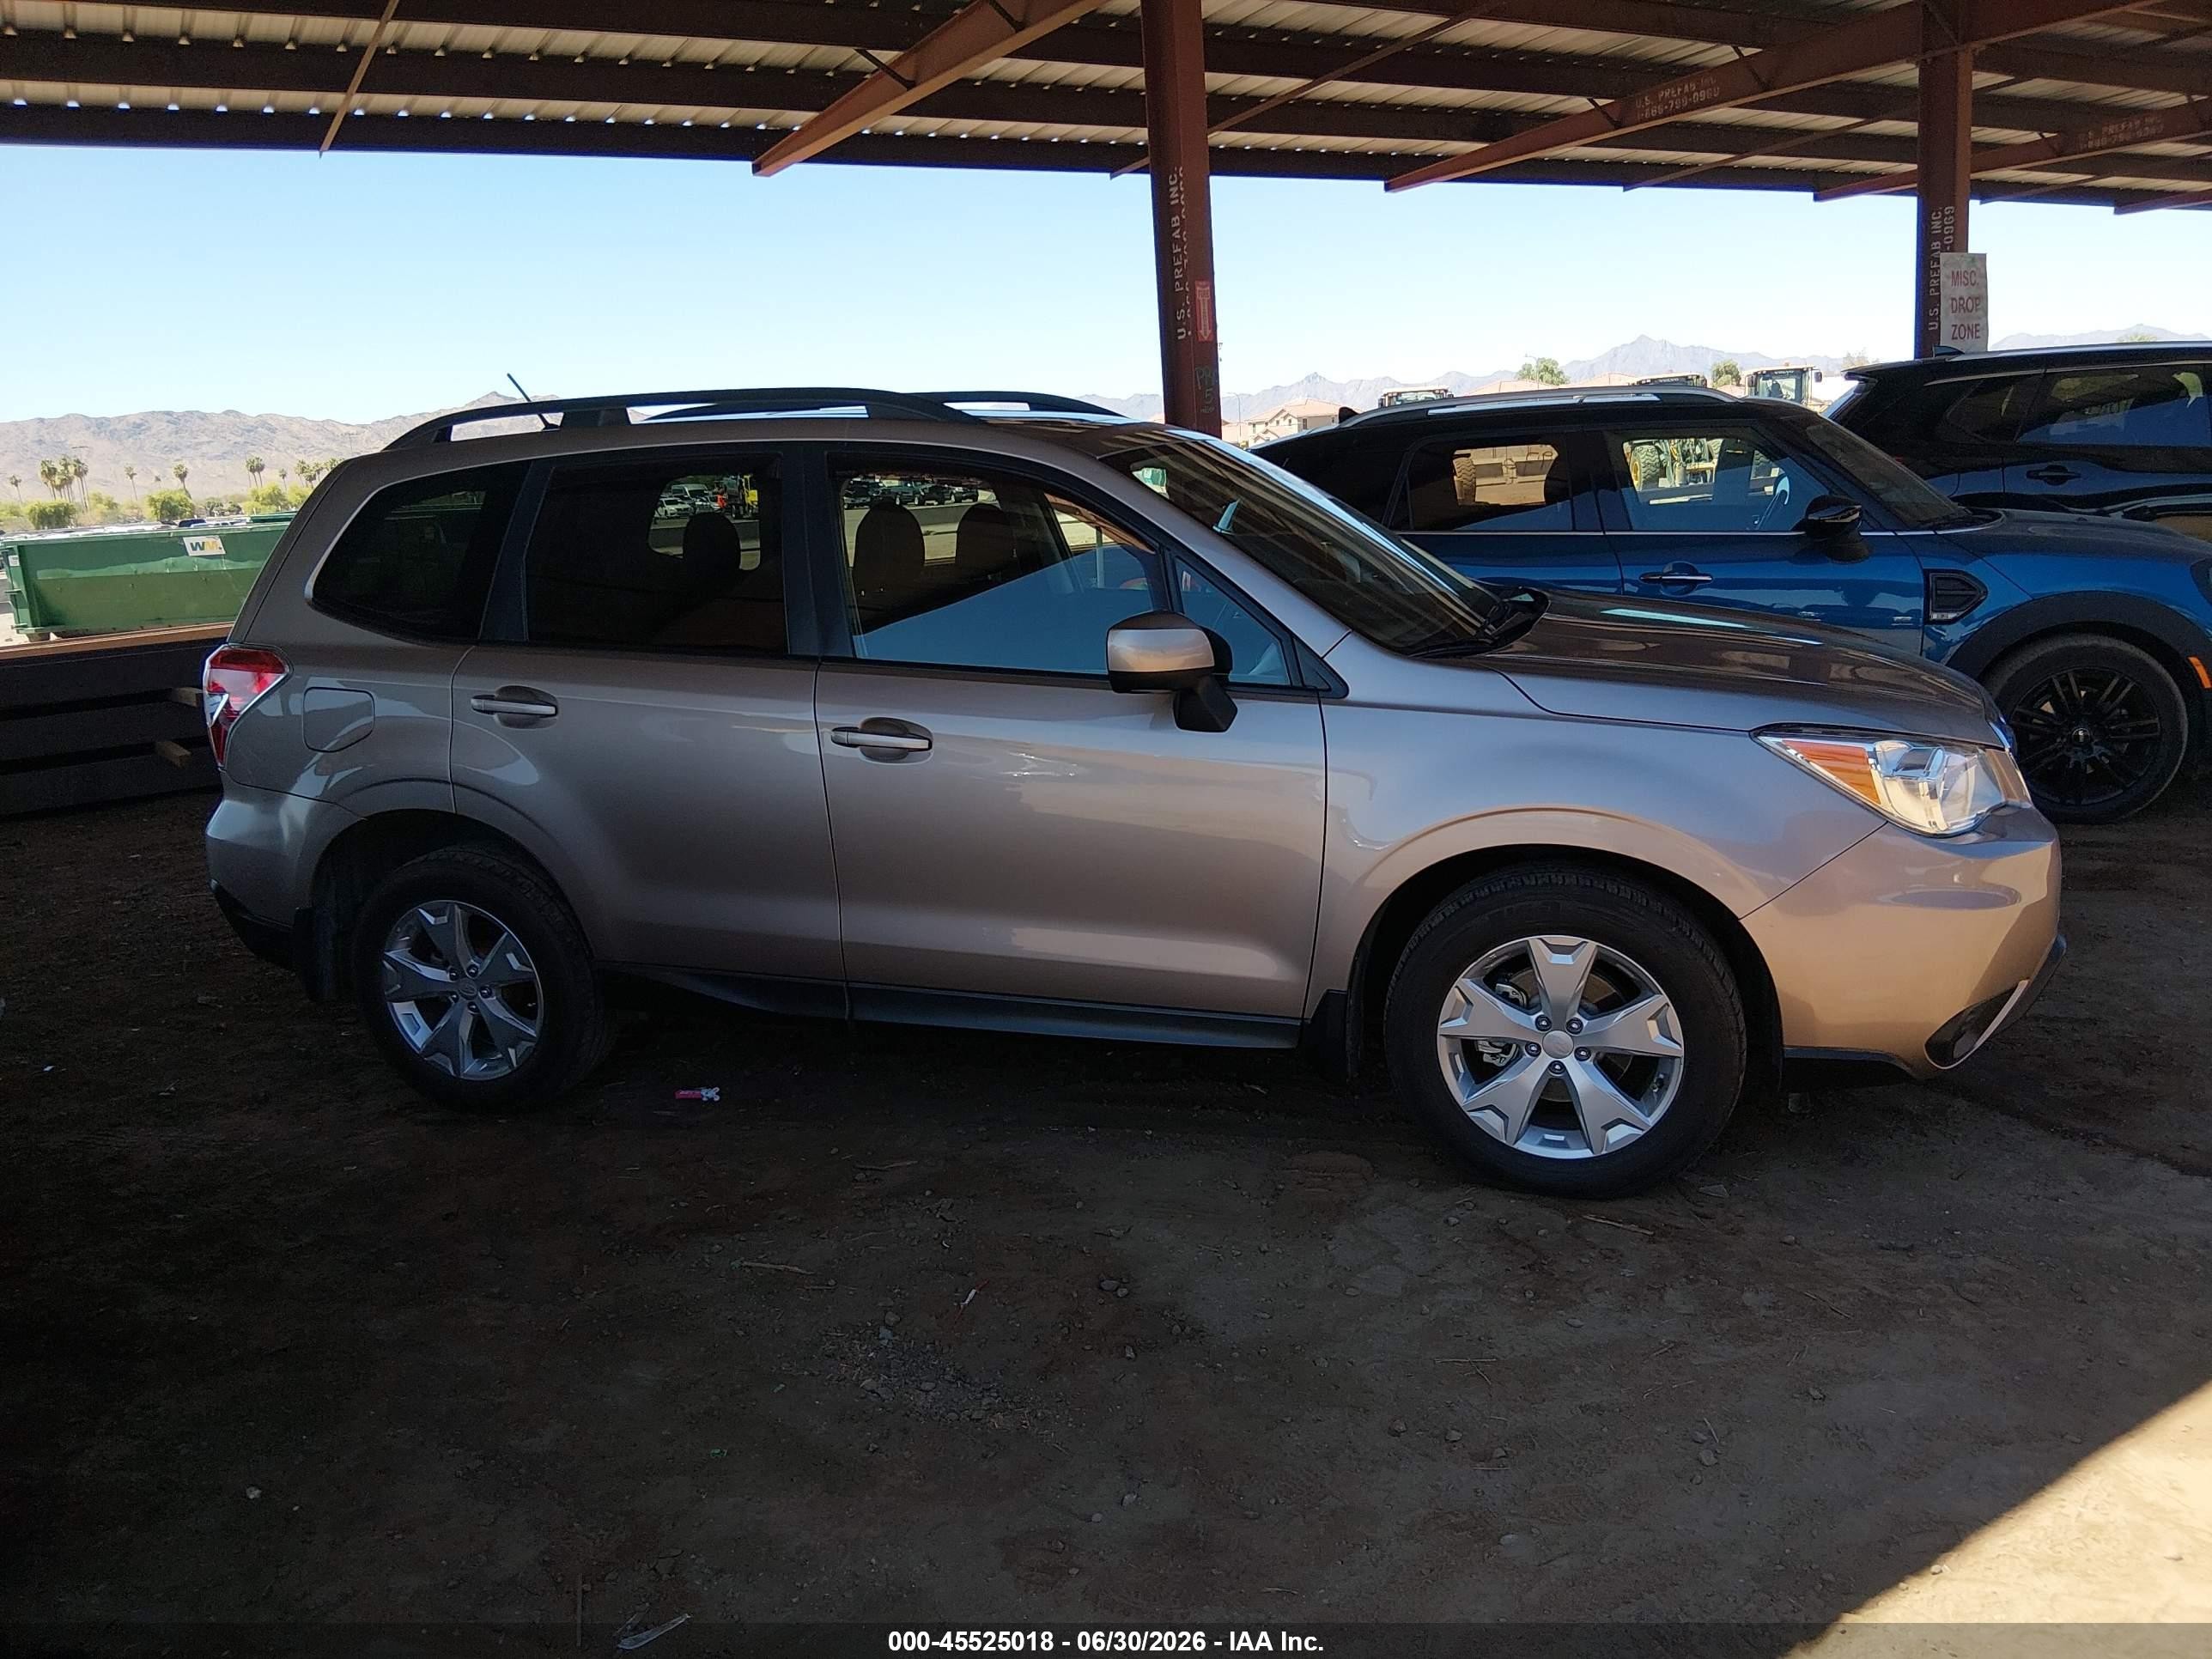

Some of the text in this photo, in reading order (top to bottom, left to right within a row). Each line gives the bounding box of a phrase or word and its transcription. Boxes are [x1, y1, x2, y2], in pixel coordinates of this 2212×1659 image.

[1168, 166, 1179, 205] INC.
[1170, 214, 1183, 293] PREFAB
[1929, 240, 1941, 297] PREFAB
[1951, 270, 1979, 287] MISC.
[1176, 302, 1187, 340] U.S.
[1928, 303, 1940, 331] U.S.
[1950, 296, 1981, 314] DROP
[1951, 323, 1981, 341] ZONE
